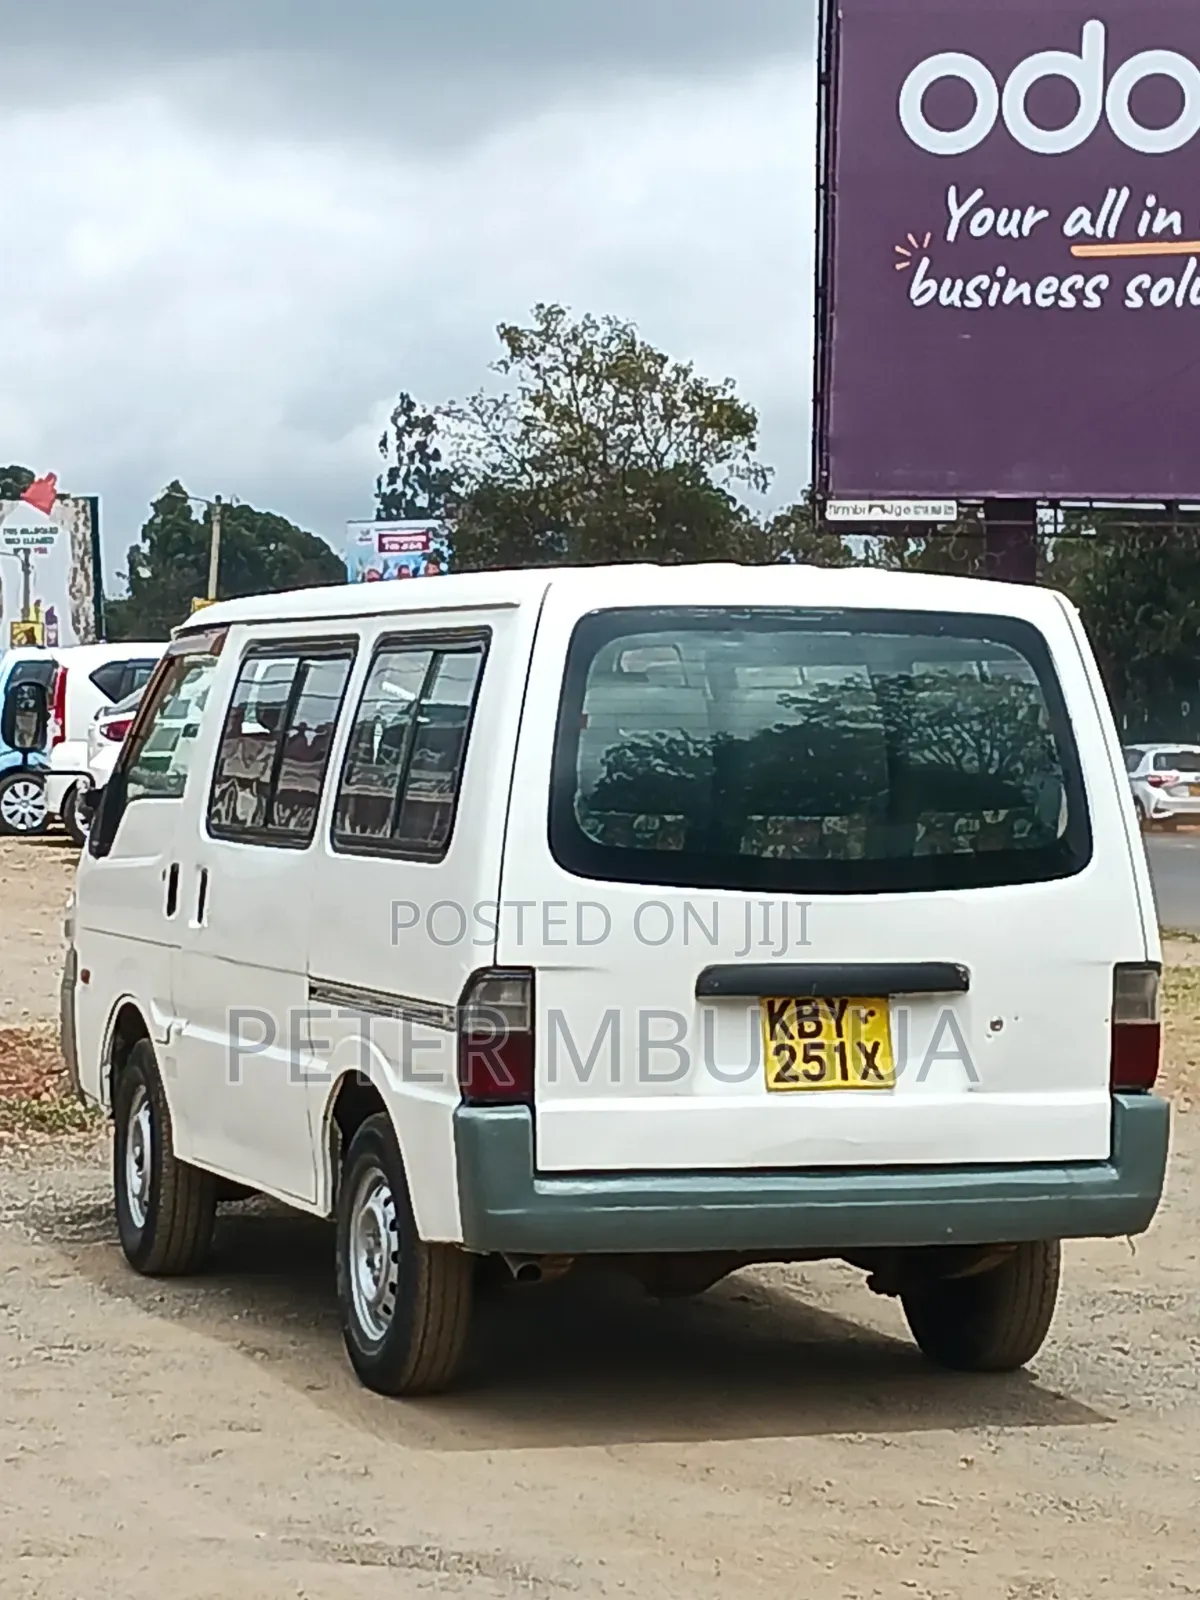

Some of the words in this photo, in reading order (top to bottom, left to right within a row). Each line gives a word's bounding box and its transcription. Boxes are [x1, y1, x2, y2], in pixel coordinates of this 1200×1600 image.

[899, 19, 1200, 155] odo
[946, 185, 1049, 242] Your
[1063, 186, 1130, 239] all
[1137, 193, 1182, 237] in
[909, 256, 1110, 309] business
[766, 998, 850, 1041] KBY
[772, 1041, 885, 1083] 251X
